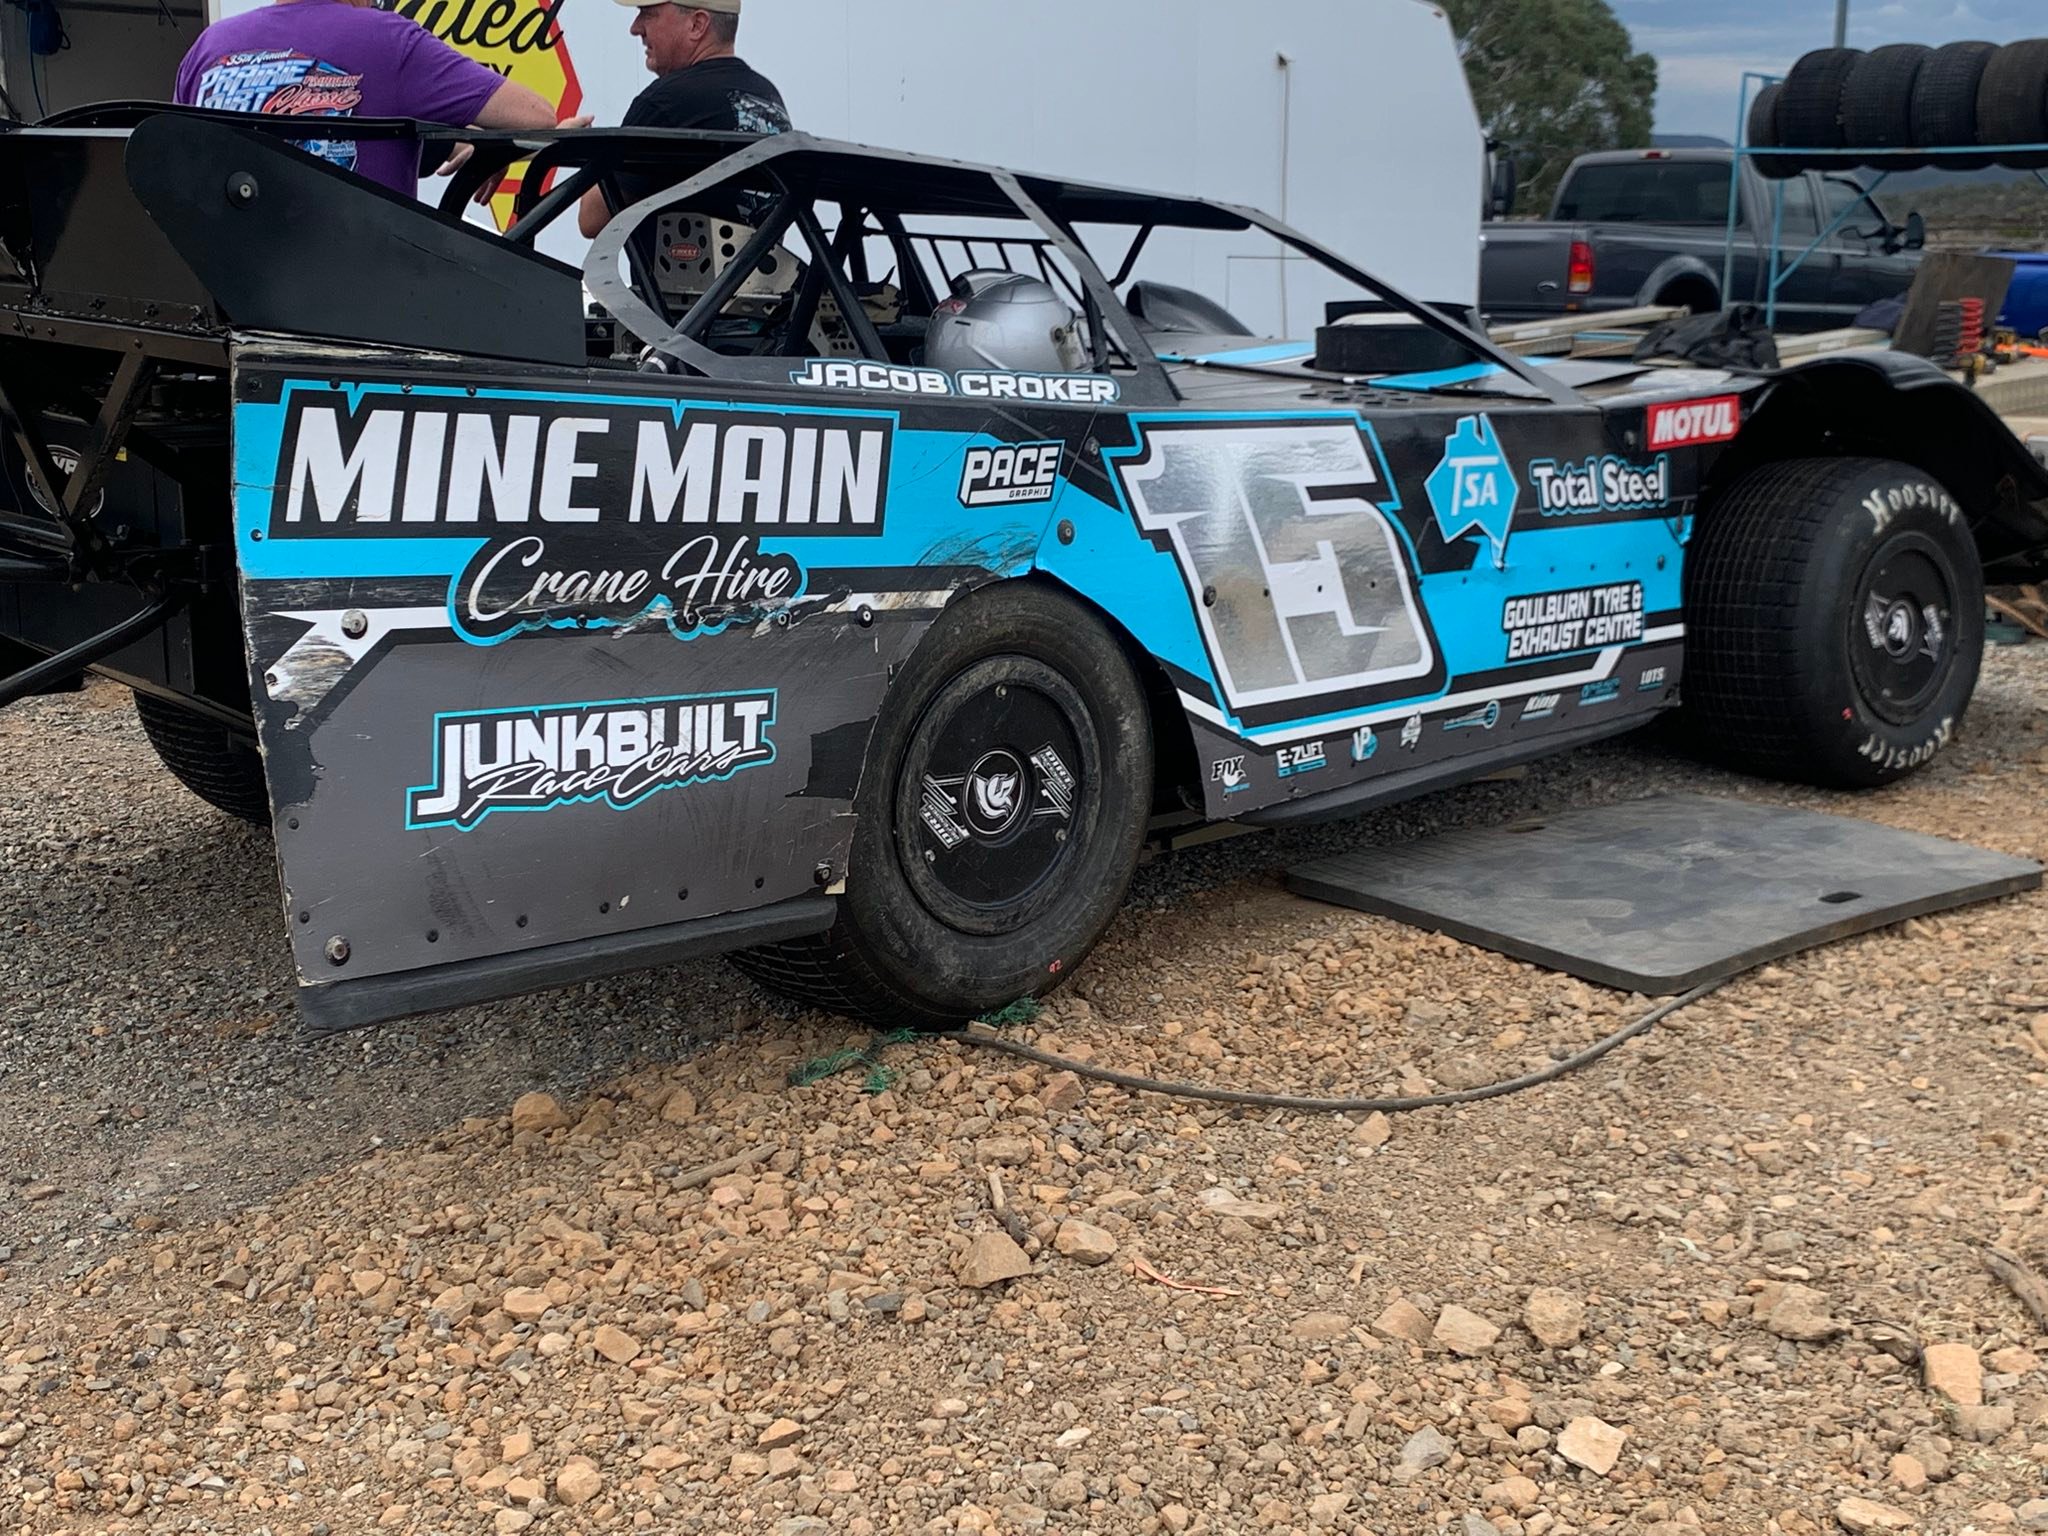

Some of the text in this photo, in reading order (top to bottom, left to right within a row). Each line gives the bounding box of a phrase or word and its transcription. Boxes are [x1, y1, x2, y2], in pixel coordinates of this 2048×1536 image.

[195, 59, 317, 108] PRAIRIE
[797, 363, 1117, 402] JACOB CROKER
[1652, 401, 1734, 444] MOTUL
[285, 407, 885, 523] MINE MAIN
[961, 446, 1060, 493] PACE
[1448, 455, 1499, 516] TSA
[1533, 461, 1665, 508] Total Steel
[1008, 487, 1050, 499] GRAPHIX
[467, 535, 793, 622] Crane Hire
[1121, 424, 1434, 702] 15
[1503, 590, 1591, 630] GOULBURN
[1592, 585, 1631, 616] TYRE
[1508, 610, 1642, 659] EXHAUST CENTRE
[416, 700, 770, 817] JUNKBUILT
[461, 741, 769, 820] Race Cars
